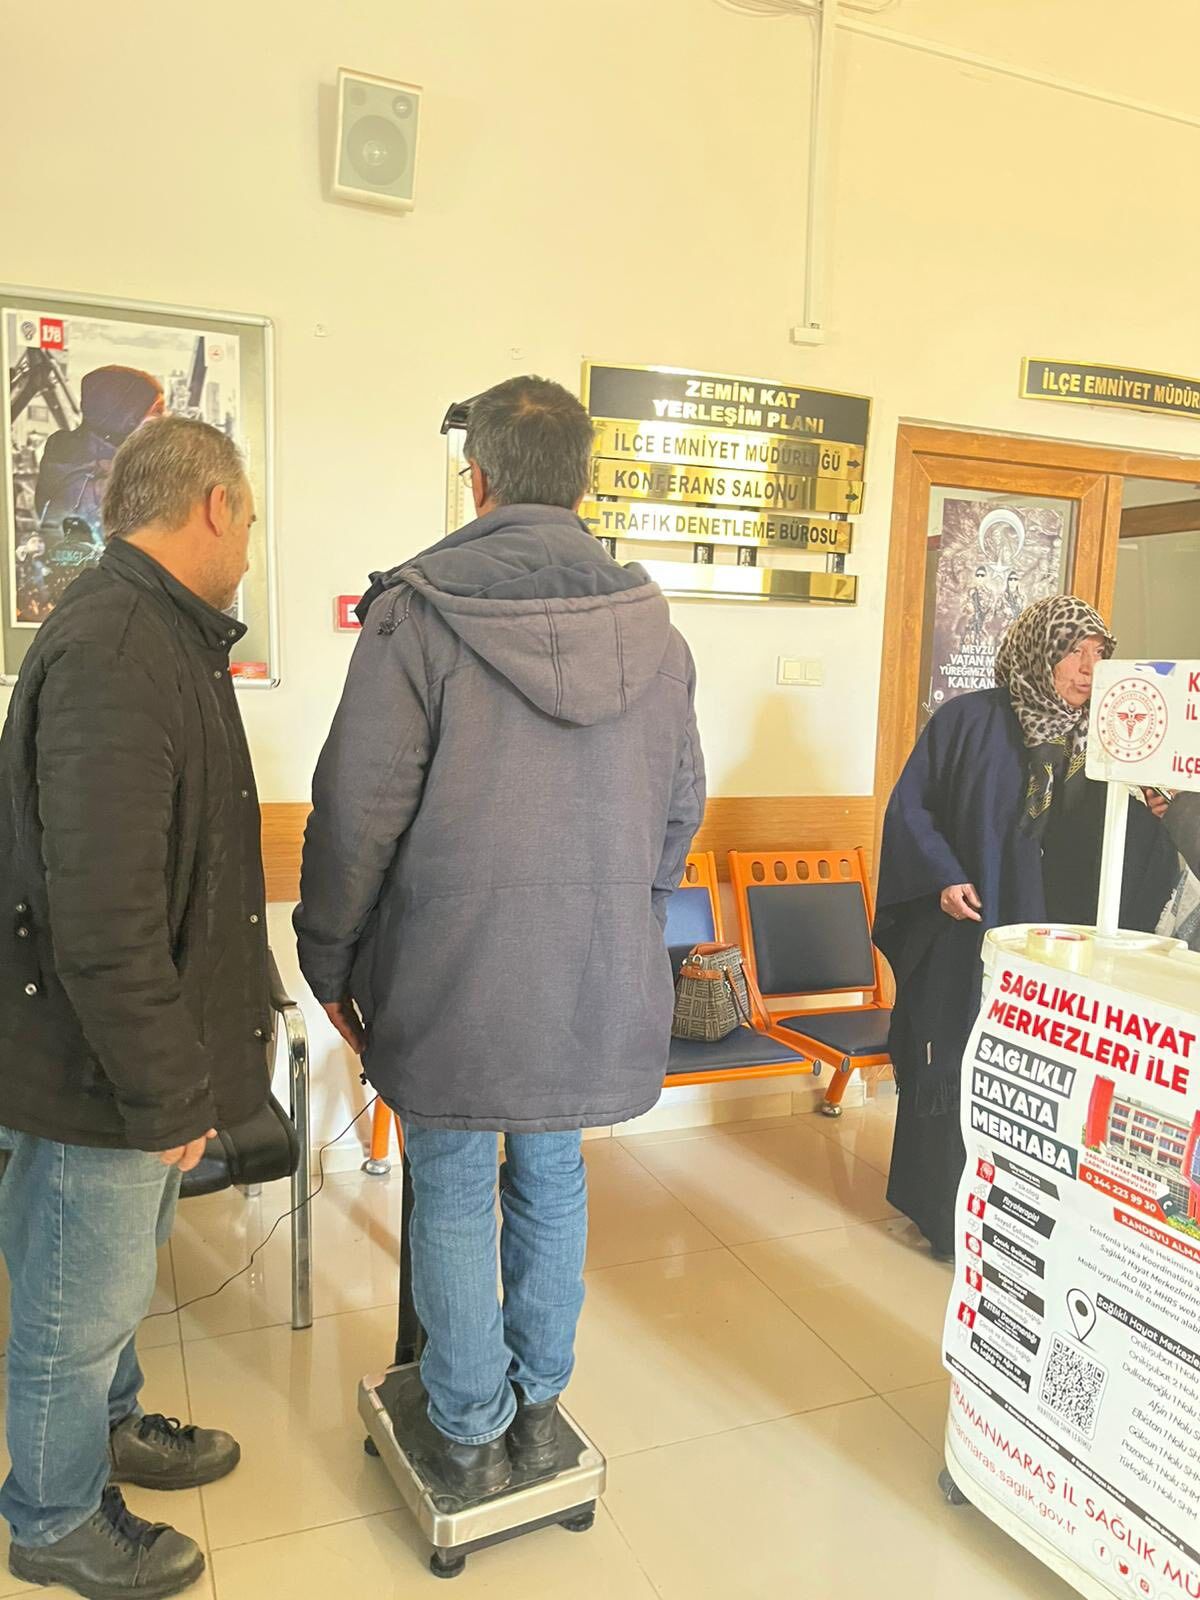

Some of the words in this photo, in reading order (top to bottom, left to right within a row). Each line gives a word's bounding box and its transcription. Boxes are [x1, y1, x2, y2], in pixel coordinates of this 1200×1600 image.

[686, 380, 753, 403] ZEMİN
[760, 389, 800, 409] KAT
[1043, 368, 1080, 394] İLÇE
[1084, 375, 1151, 400] EMNİYET
[1155, 383, 1200, 408] MÜDÜR
[653, 400, 762, 427] YERLEŞİM
[767, 412, 824, 433] PLANI
[663, 434, 739, 460] EMNİYET
[614, 470, 725, 497] KONFERANS
[732, 480, 798, 501] SALONU
[676, 515, 775, 539] DENETLEME
[780, 520, 838, 545] BÜROSU
[950, 654, 983, 666] VATAN
[961, 645, 994, 655] MEVZU
[999, 970, 1100, 1024] SAĞLIKLI
[1105, 1006, 1196, 1058] HAYAT
[978, 1038, 1074, 1095] SAĞLIKLI
[987, 998, 1140, 1075] MERKEZLERİ
[1146, 1055, 1190, 1095] İLE
[974, 1072, 1055, 1128] HAYATA
[973, 1106, 1073, 1176] MERHABA
[1085, 1172, 1092, 1181] 0
[1094, 1174, 1111, 1190] 344
[1144, 1200, 1157, 1213] 30
[1121, 1215, 1169, 1245] RANDEVU
[1089, 1225, 1121, 1248] Telefonla
[1123, 1244, 1141, 1259] Vaka
[1142, 1255, 1193, 1288] Koordinatörü
[1100, 1243, 1126, 1264] Sağlıklı
[1127, 1259, 1149, 1278] Hayat
[1077, 1256, 1097, 1273] Mobil
[1098, 1270, 1134, 1294] uygulama
[1145, 1297, 1180, 1321] Randevu
[1121, 1271, 1138, 1284] ALO
[1154, 1289, 1177, 1308] MHRS
[1179, 1305, 1196, 1318] web
[1097, 1296, 1128, 1322] Sağlıklı
[1128, 1318, 1159, 1340] Hayat
[1159, 1335, 1200, 1367] Merkezle
[952, 1379, 1056, 1494] RAMANMARAŞ
[1063, 1477, 1078, 1507] İL
[1085, 1498, 1156, 1568] SAĞLIK
[953, 1418, 1077, 1535] anmaras.saglik.gov.tr
